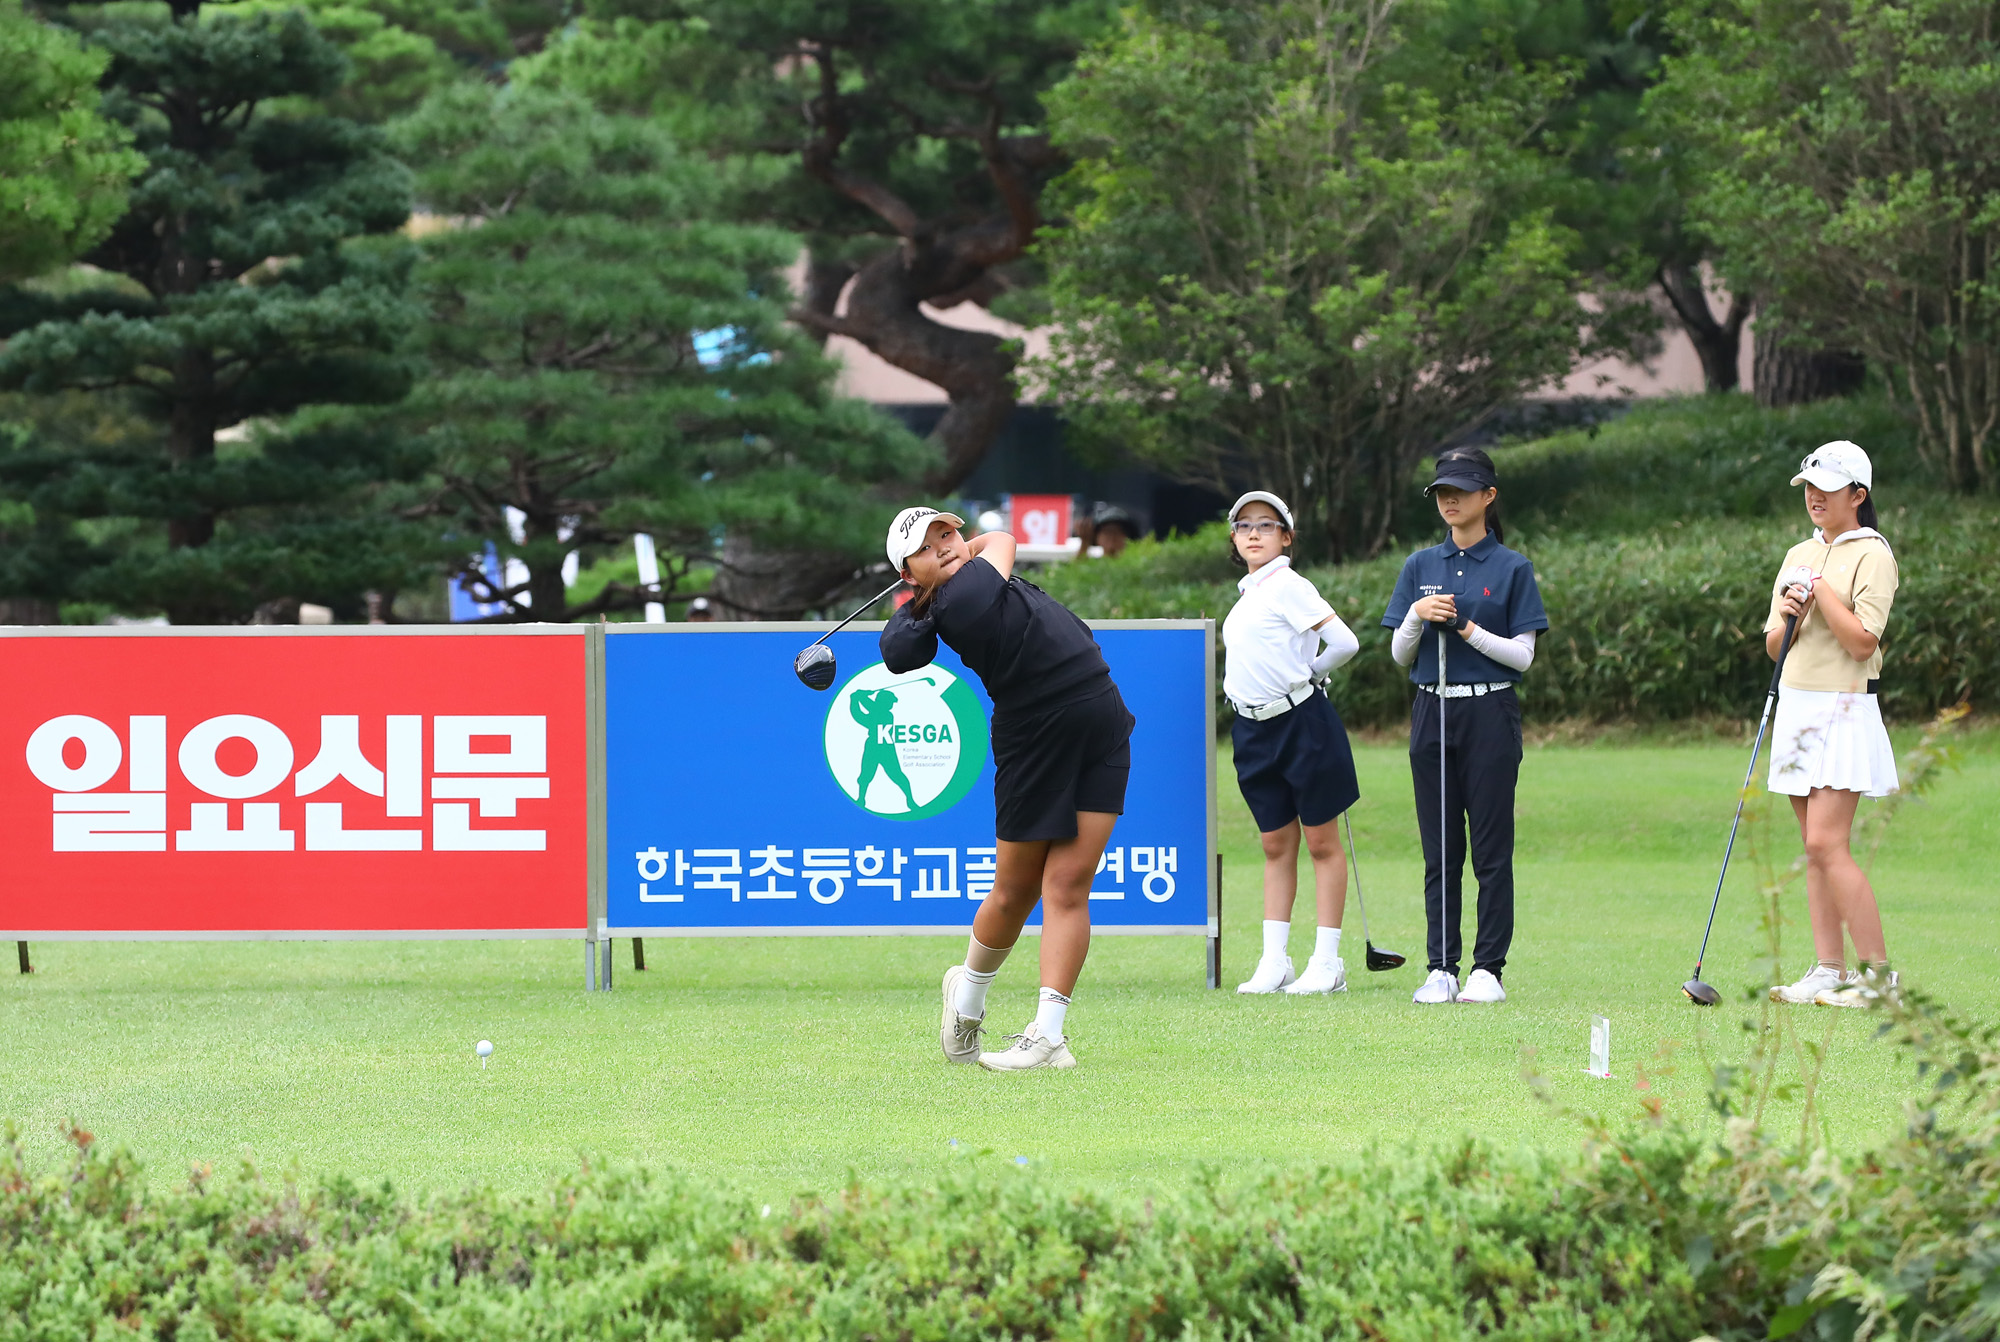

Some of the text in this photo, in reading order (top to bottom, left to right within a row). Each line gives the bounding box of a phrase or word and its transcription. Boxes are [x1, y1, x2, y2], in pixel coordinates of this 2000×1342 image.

[877, 724, 953, 745] KESGA
[25, 714, 550, 852] 일요신문
[636, 845, 1177, 903] 한국초등학교골연맹
